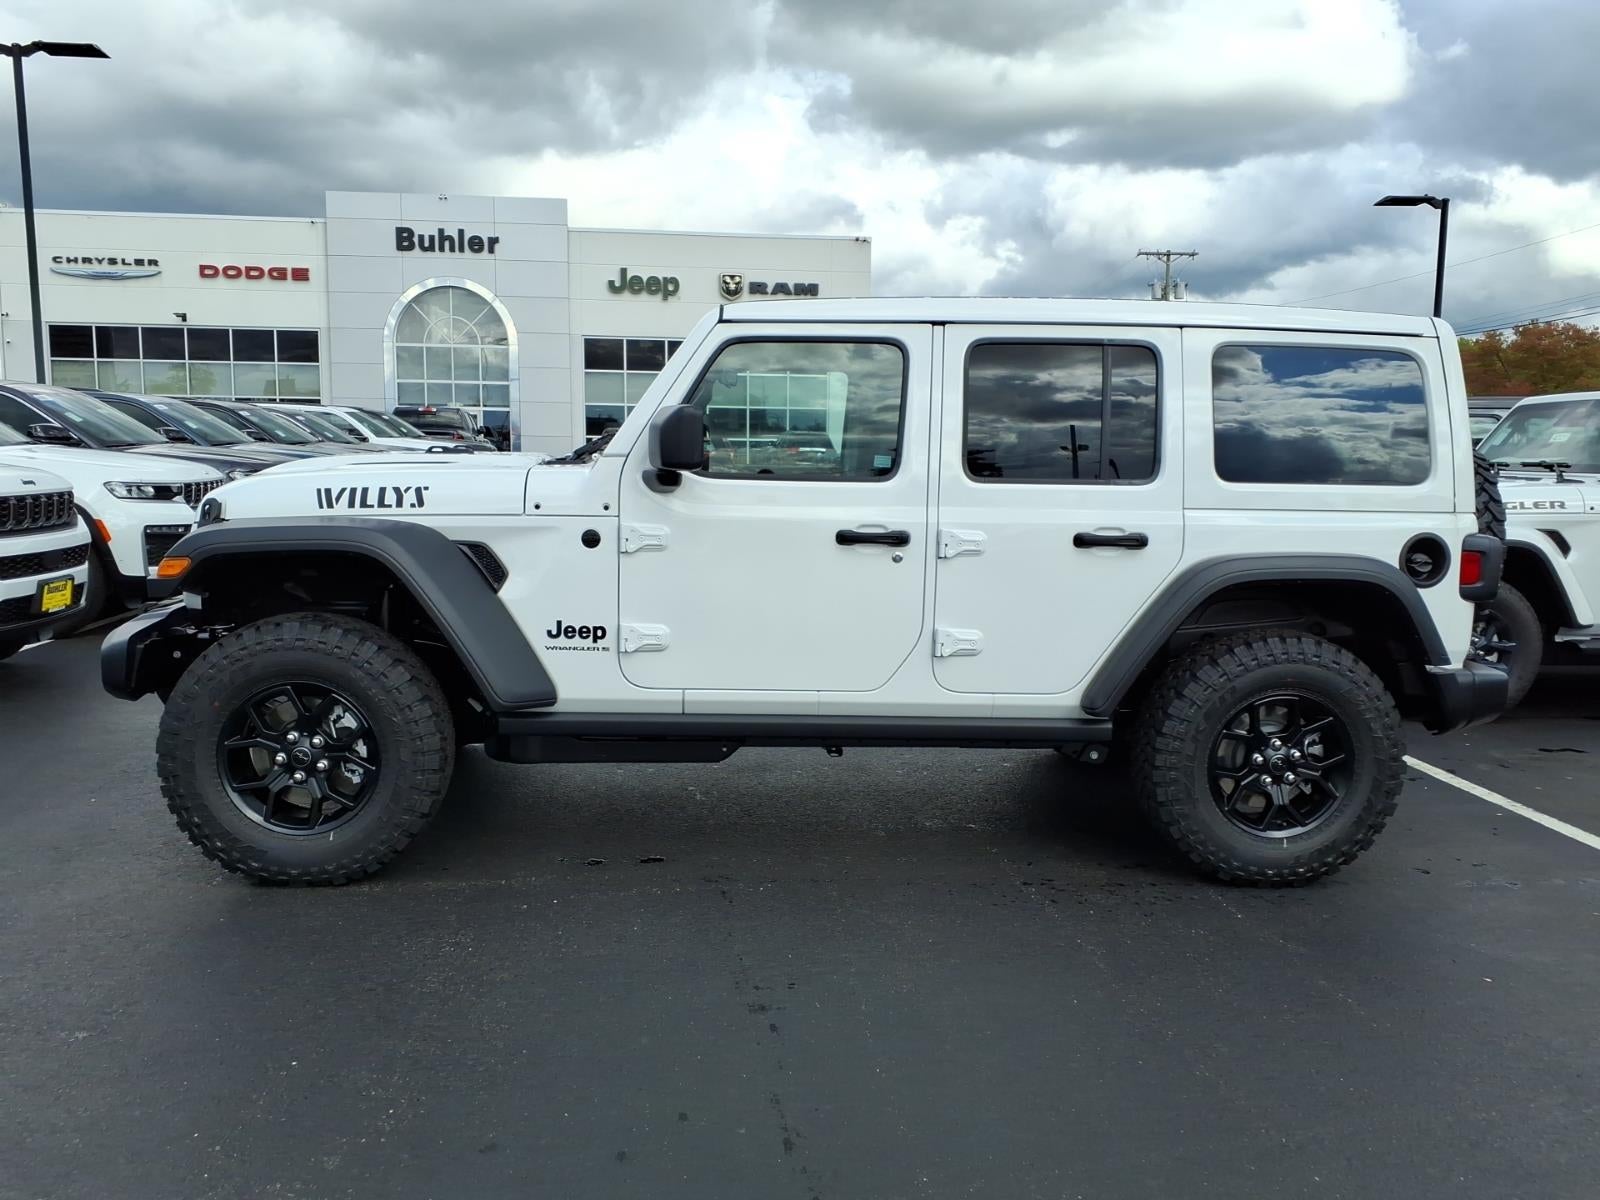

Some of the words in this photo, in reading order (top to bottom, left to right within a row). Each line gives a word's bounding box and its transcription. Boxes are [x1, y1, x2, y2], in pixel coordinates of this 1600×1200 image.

[395, 226, 499, 254] Buhler
[51, 255, 160, 267] CHRYSLER
[199, 264, 310, 282] DODGE
[607, 267, 680, 301] Jeep
[748, 281, 819, 297] RAM
[316, 486, 430, 510] WILLYS
[546, 619, 607, 644] Jeep
